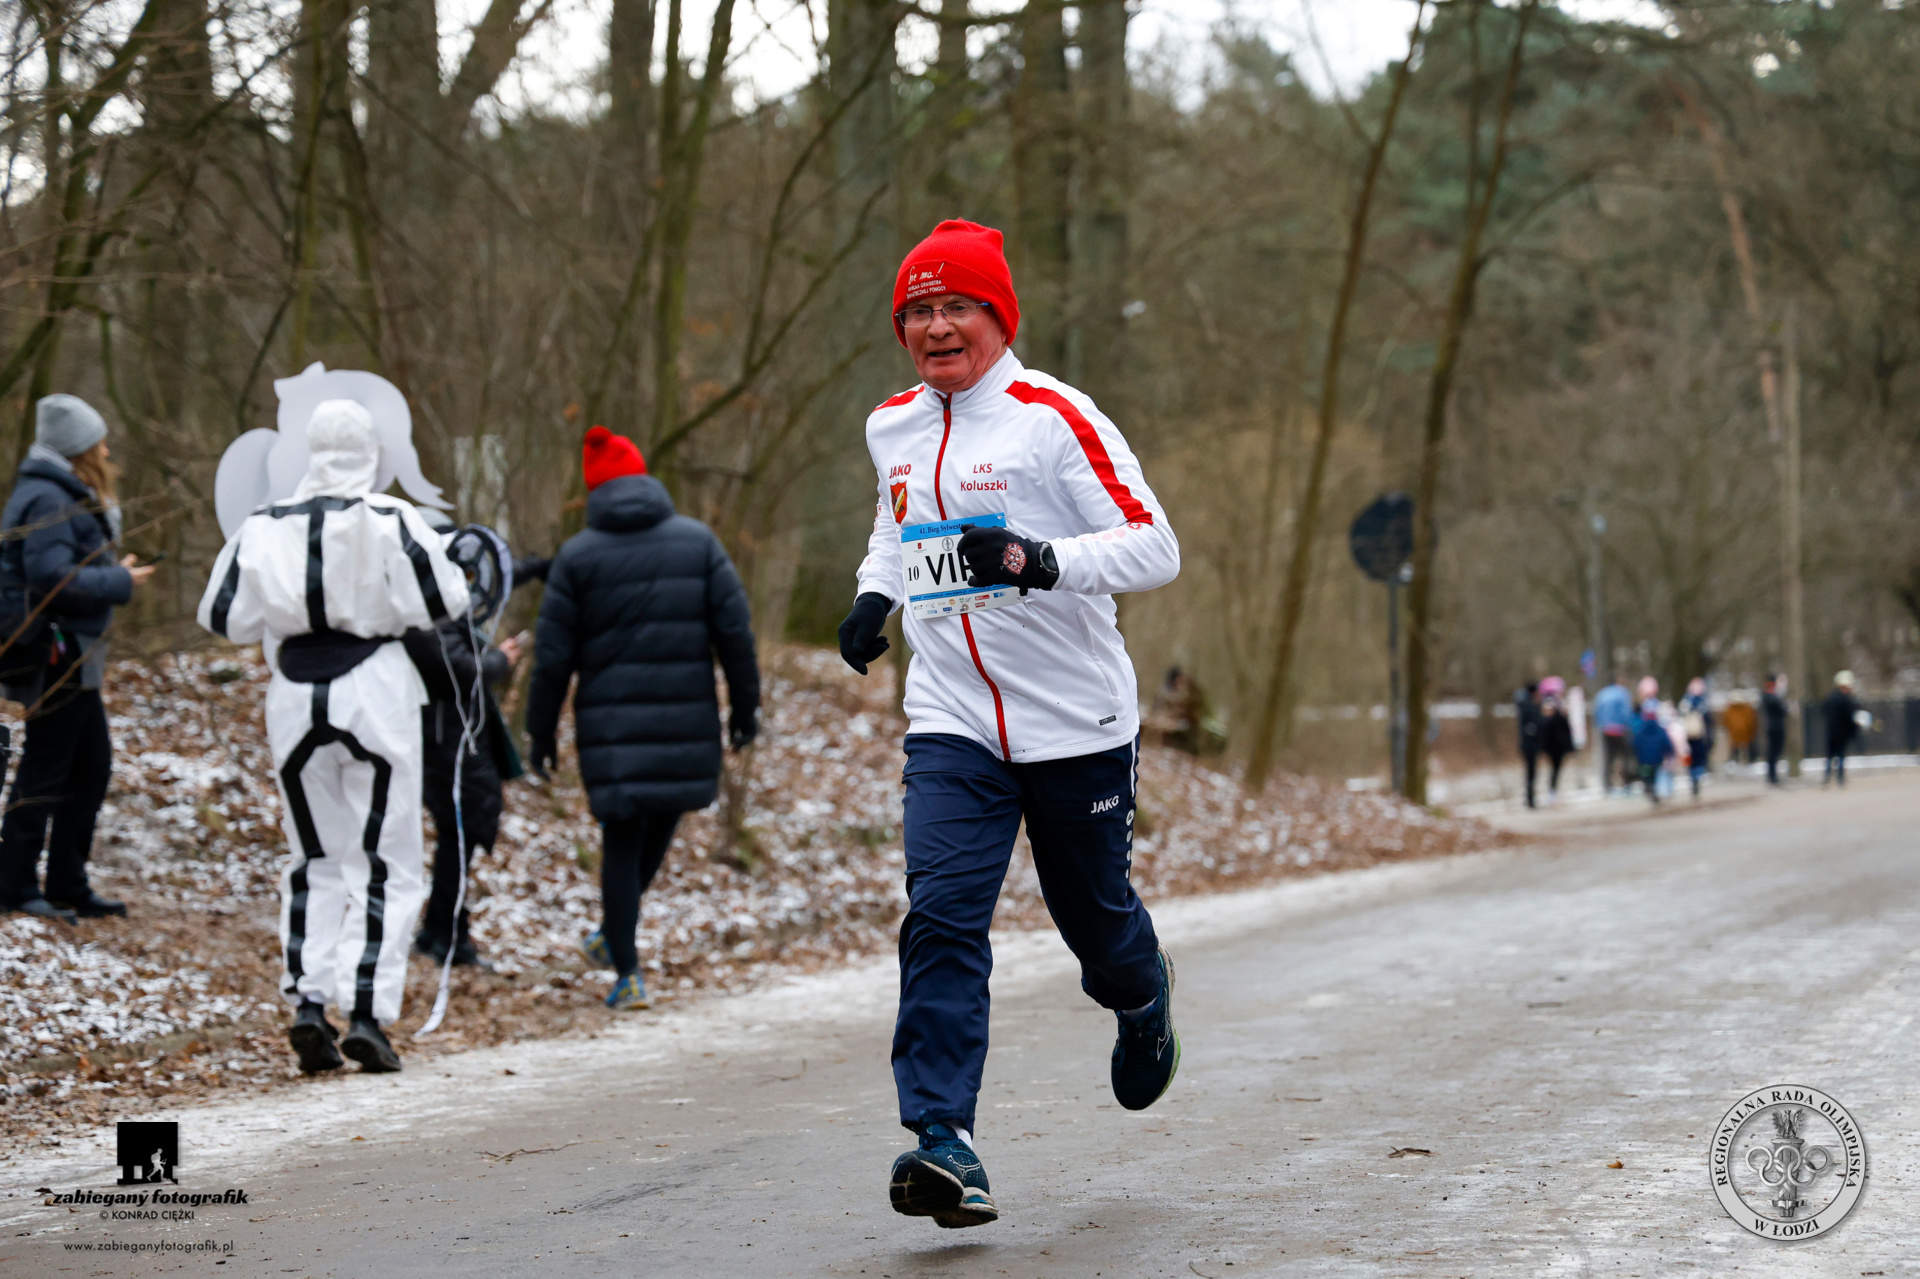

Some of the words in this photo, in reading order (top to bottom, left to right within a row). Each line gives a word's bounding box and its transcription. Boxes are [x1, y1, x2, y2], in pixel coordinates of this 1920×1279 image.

[889, 464, 912, 479] JAKO
[973, 463, 993, 474] LKS
[960, 480, 1008, 492] Koluszki
[908, 565, 920, 581] 10
[1090, 795, 1120, 814] JAKO
